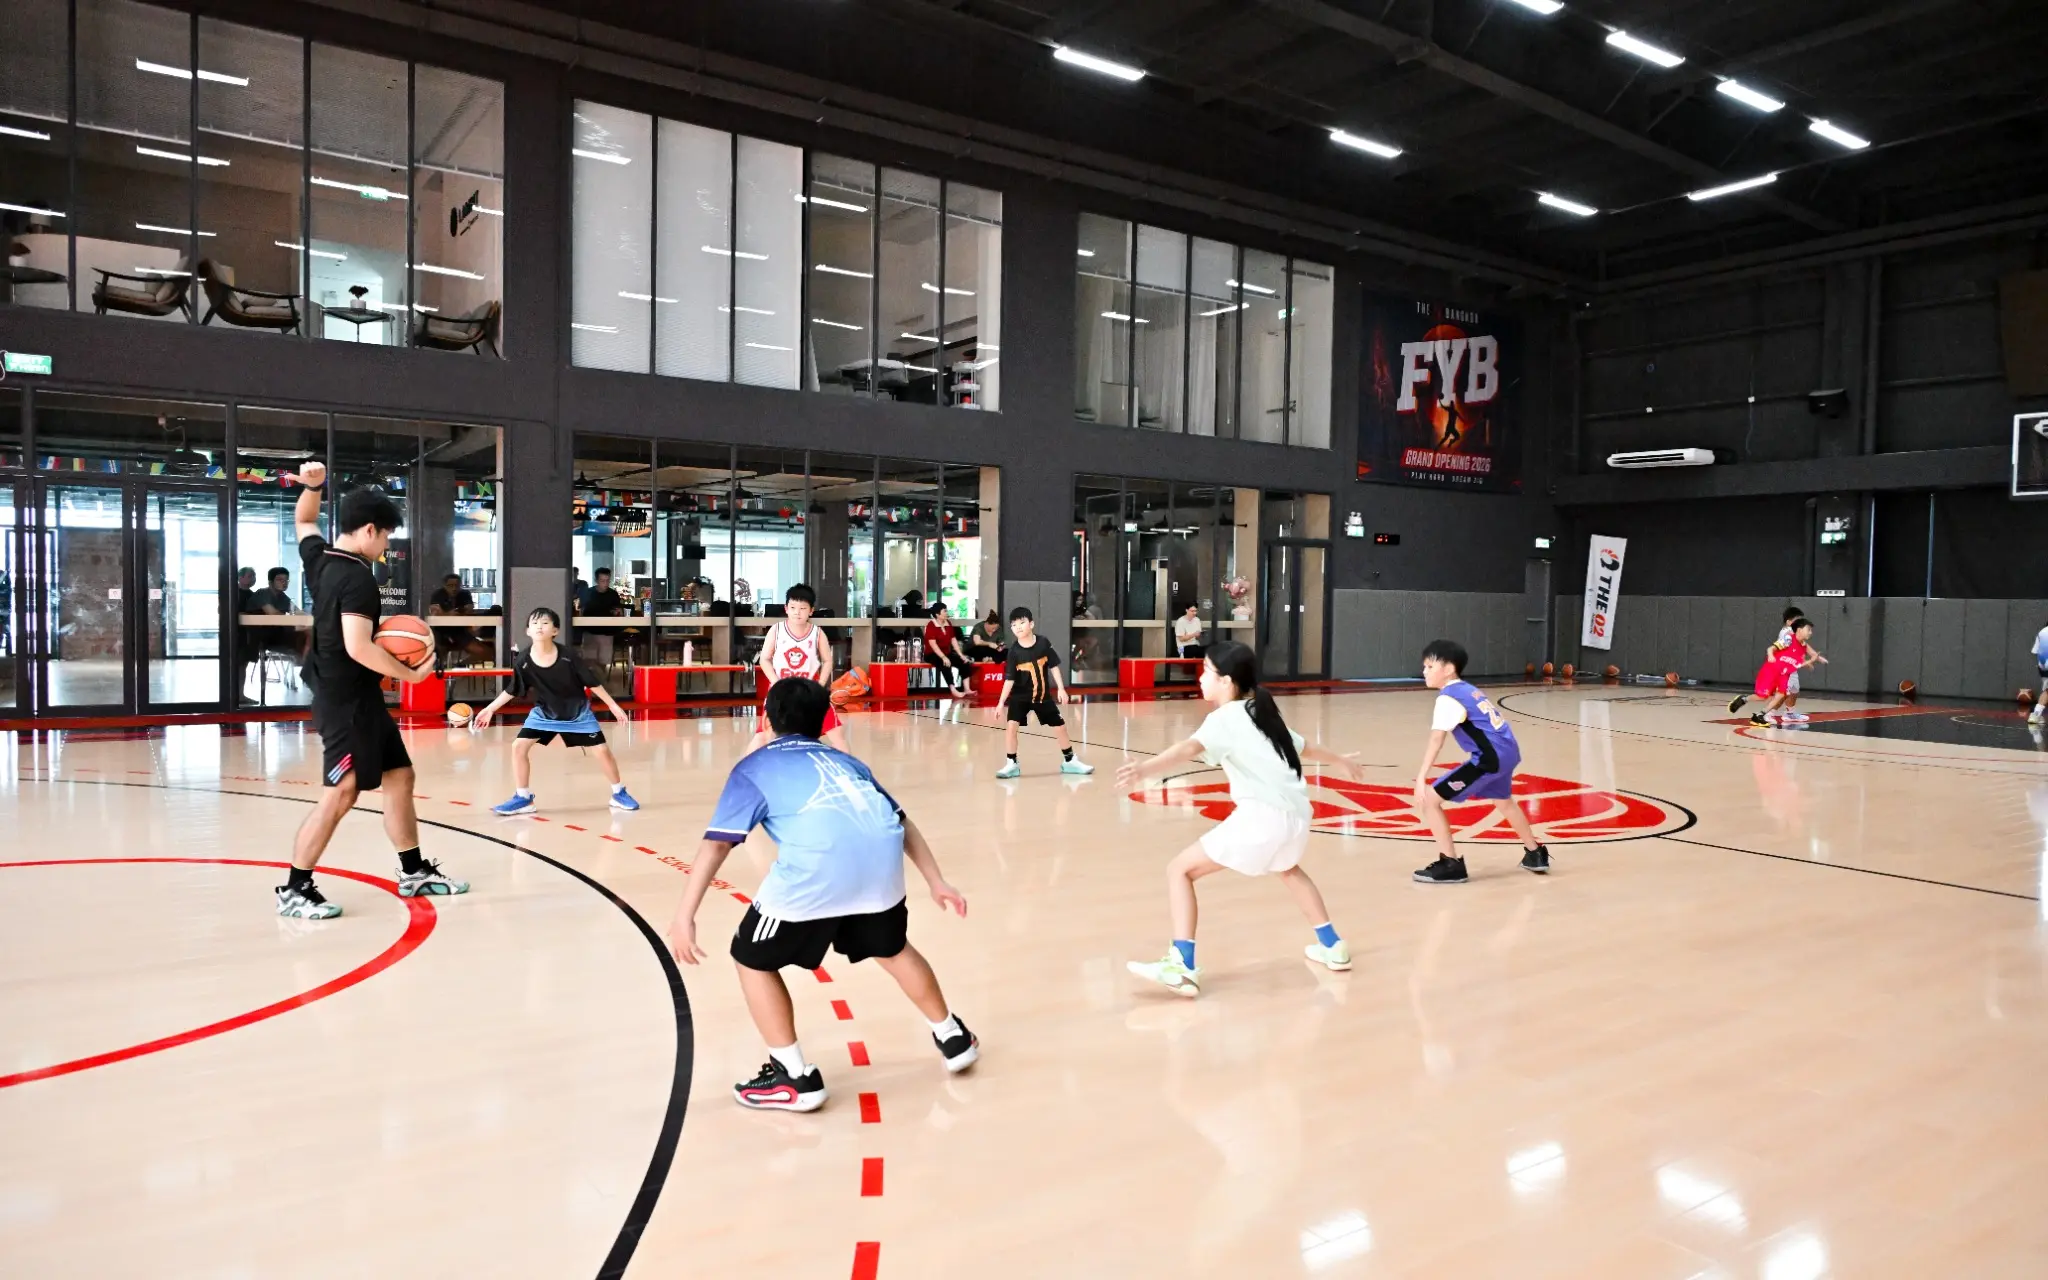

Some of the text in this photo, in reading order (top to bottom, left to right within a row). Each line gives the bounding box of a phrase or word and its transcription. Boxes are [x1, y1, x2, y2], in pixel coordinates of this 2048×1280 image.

[1417, 302, 1430, 315] THE
[1397, 335, 1499, 411] FYB
[1405, 450, 1491, 473] GRAND OPENING 2026
[1411, 472, 1426, 480] PLAY
[1596, 576, 1612, 614] THE
[984, 673, 1003, 681] FYB
